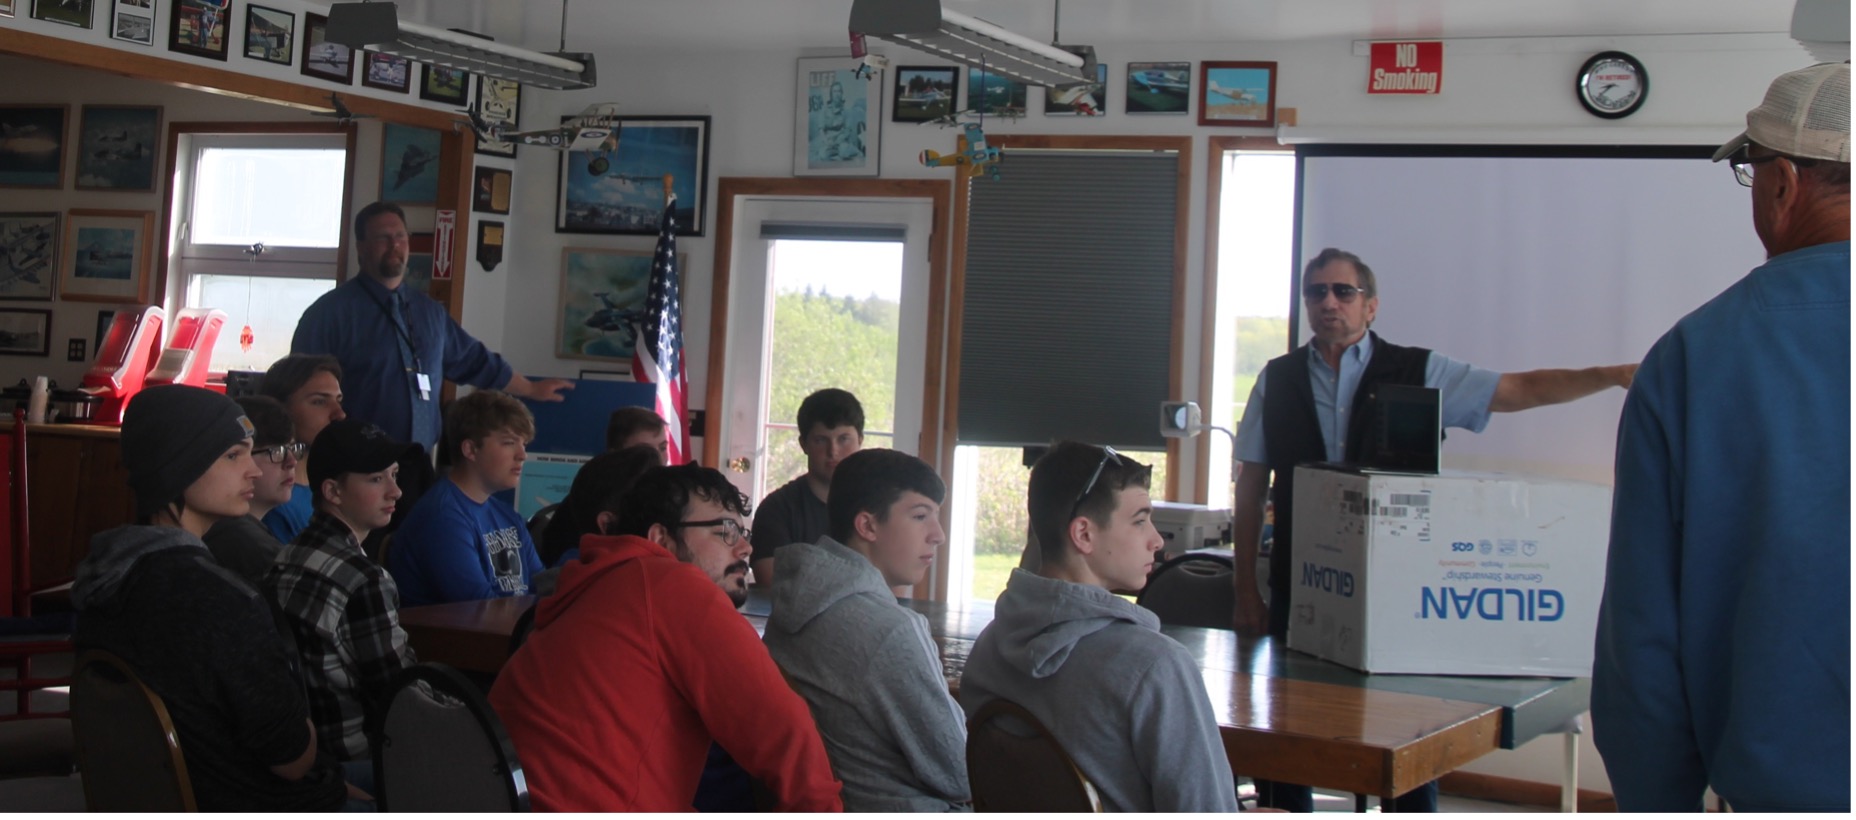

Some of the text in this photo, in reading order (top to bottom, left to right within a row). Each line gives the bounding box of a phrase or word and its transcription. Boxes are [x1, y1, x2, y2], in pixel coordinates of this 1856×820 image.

[1395, 44, 1417, 68] NO
[1373, 68, 1438, 93] Smoking
[1451, 542, 1474, 551] GQS
[1438, 560, 1475, 568] Community
[1303, 561, 1354, 598] GILDAN
[1504, 573, 1543, 583] Genuine
